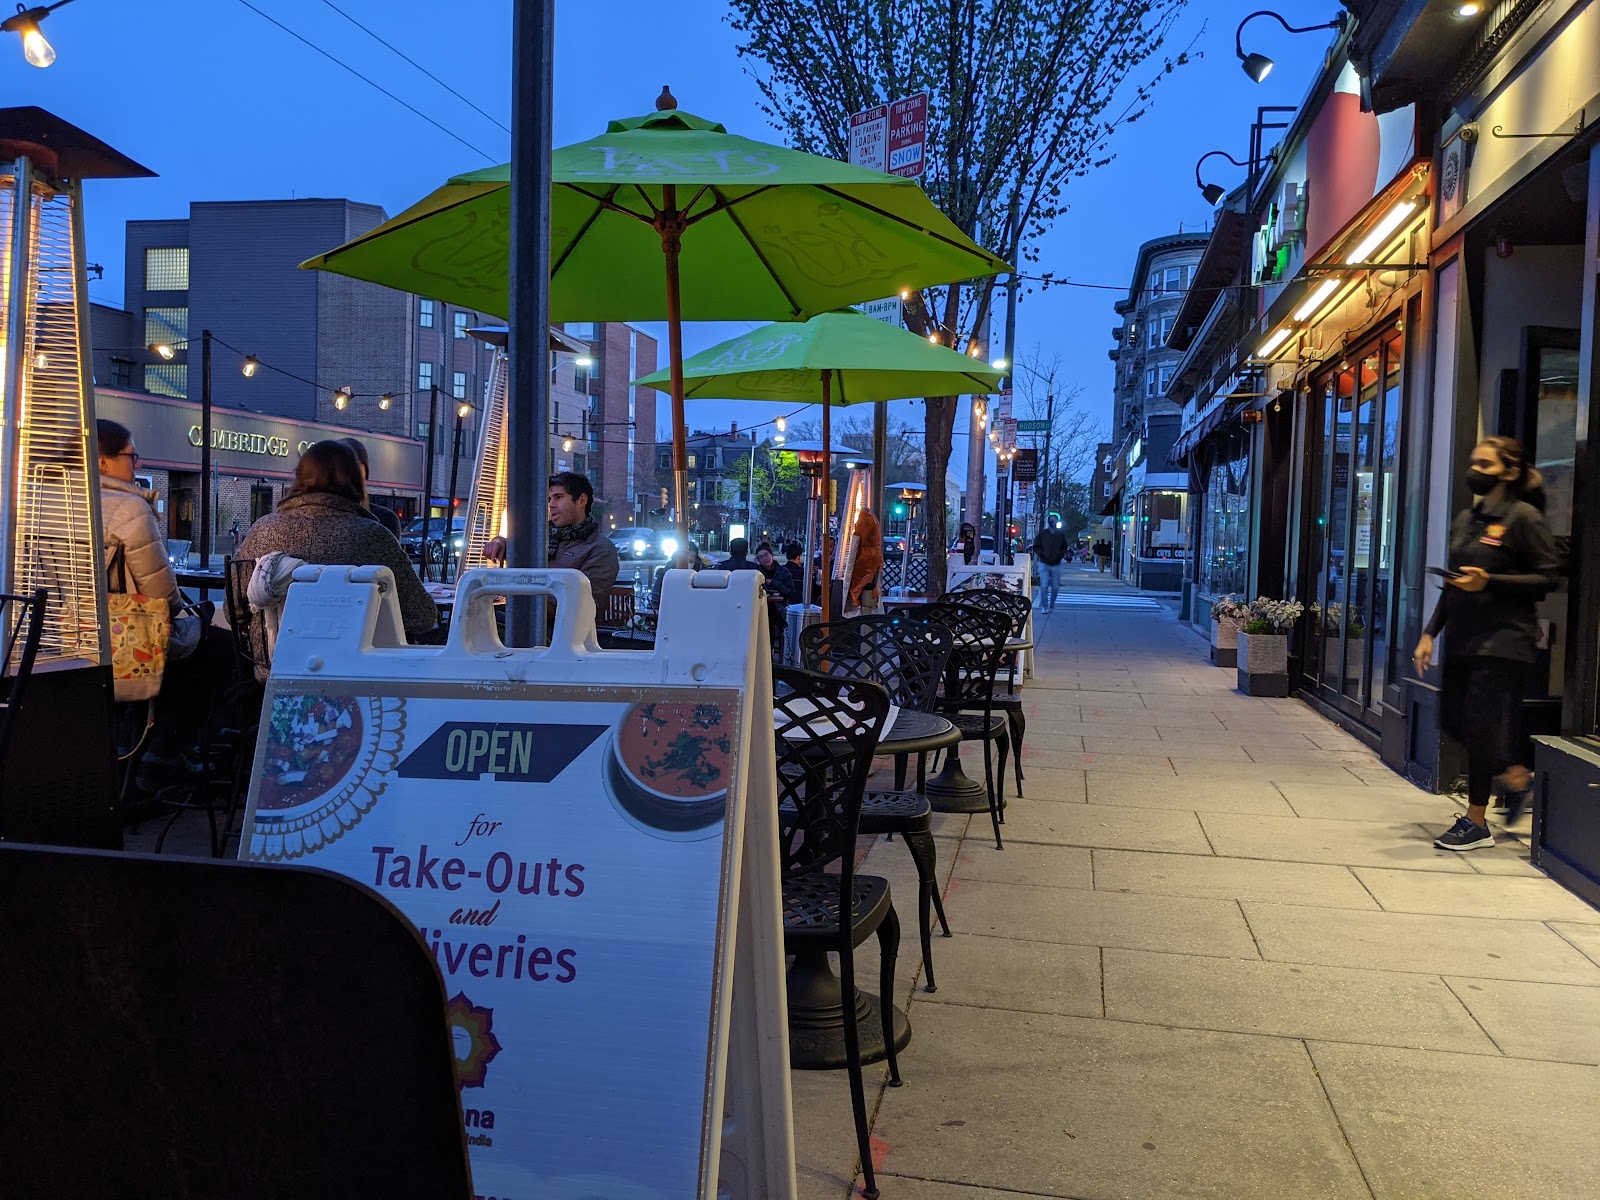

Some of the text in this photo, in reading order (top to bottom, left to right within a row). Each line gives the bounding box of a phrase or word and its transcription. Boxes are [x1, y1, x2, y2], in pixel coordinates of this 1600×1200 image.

[895, 98, 921, 114] TOW ZONE
[855, 108, 883, 125] TOW ZONE
[902, 112, 913, 124] NO
[862, 122, 883, 134] PARKING
[890, 120, 924, 141] PARKING
[855, 132, 881, 148] LOADING
[860, 145, 875, 157] ONLY
[891, 146, 921, 167] SNOW
[868, 301, 897, 314] 8AM-8PM
[1019, 421, 1045, 430] HUDSON
[188, 425, 290, 457] CMBRIDGE
[1156, 549, 1171, 557] CUTS
[445, 728, 533, 774] OPEN
[454, 813, 502, 847] for
[371, 845, 586, 898] Take-Outs
[448, 899, 501, 927] and
[420, 927, 578, 984] iveries
